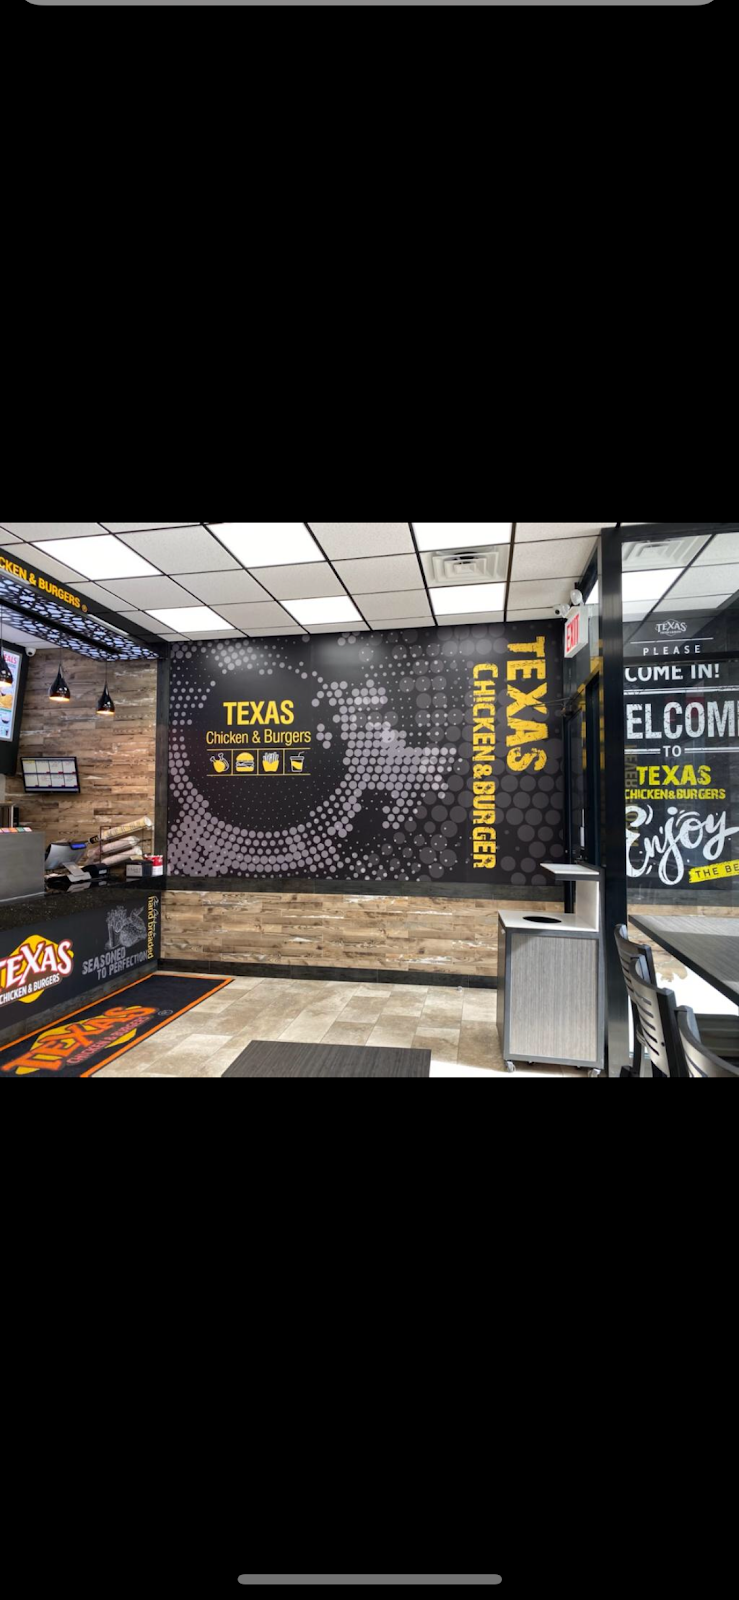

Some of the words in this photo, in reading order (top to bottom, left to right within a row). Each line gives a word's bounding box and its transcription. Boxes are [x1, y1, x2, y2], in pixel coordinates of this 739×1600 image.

[28, 572, 37, 586] &
[38, 577, 81, 609] BURGERS
[566, 614, 579, 652] EXIT
[655, 621, 687, 633] TEXAS
[643, 644, 701, 657] PLEASE
[624, 665, 683, 682] COME
[690, 663, 720, 680] IN!
[222, 699, 295, 726] TEXAS
[505, 636, 547, 772] TEXAS
[206, 730, 249, 745] Chicken
[251, 730, 261, 744] &
[263, 729, 311, 746] Burgers
[662, 745, 682, 757] TO
[636, 764, 712, 786] TEXAS
[625, 805, 739, 886] Enjoy
[694, 866, 720, 879] THE
[147, 896, 156, 920] hand
[147, 921, 157, 959] breaded
[81, 946, 126, 975] SEASONED
[97, 966, 107, 981] TO
[108, 950, 148, 976] PERFECTION
[0, 985, 27, 1005] CHICKEN
[28, 983, 33, 994] &
[33, 973, 60, 992] BURGERS
[1, 1007, 157, 1071] TEXAS
[66, 1039, 109, 1065] CHICKEN
